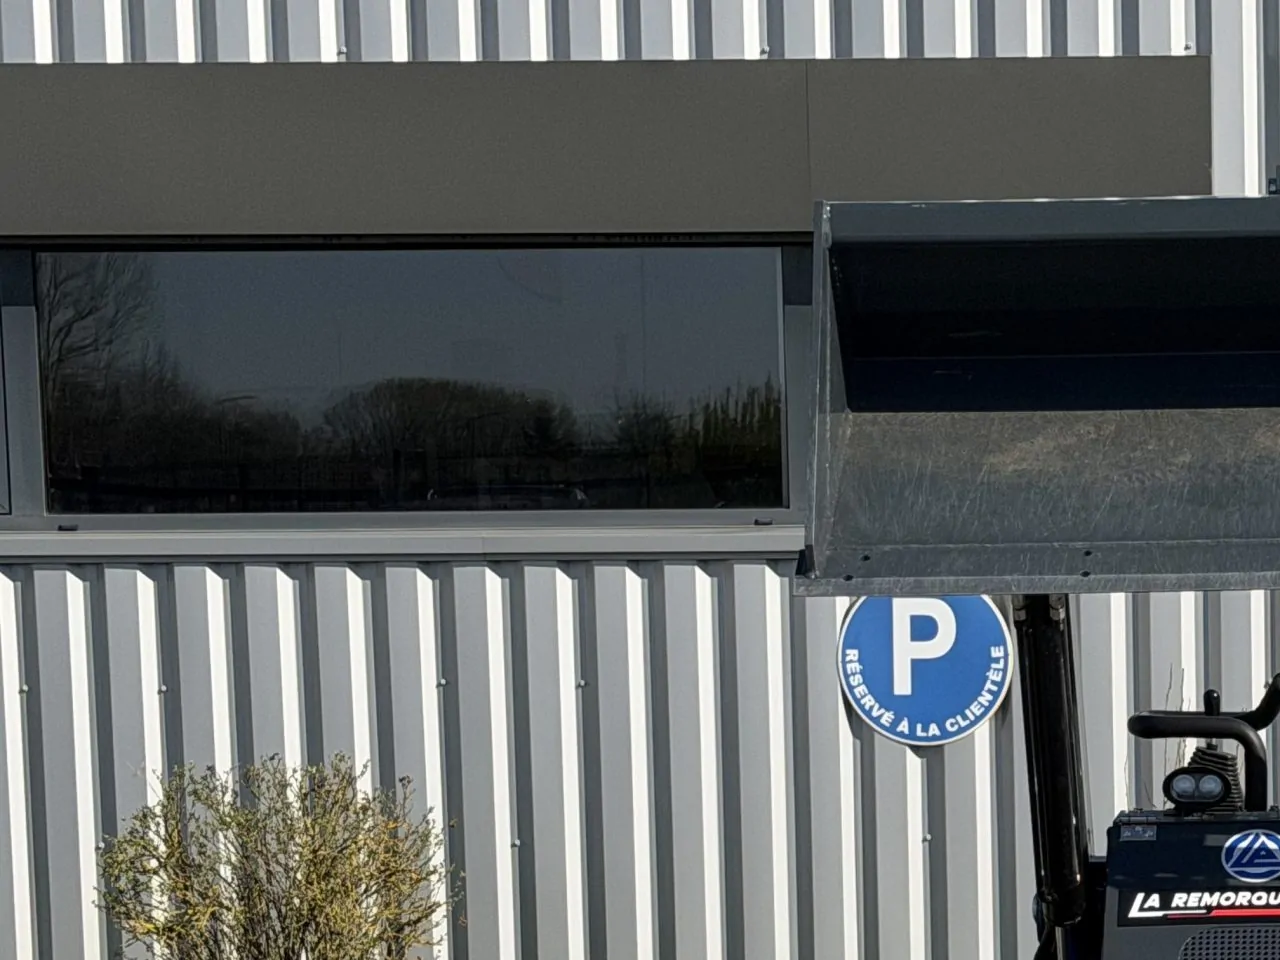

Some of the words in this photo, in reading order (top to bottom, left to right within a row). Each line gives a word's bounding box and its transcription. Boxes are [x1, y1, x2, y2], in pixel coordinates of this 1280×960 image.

[846, 649, 894, 727] RÉSERVÉ
[897, 718, 909, 734] À
[916, 723, 940, 736] LA
[945, 646, 1004, 731] CLIENTÈLE
[893, 597, 956, 695] P
[1128, 892, 1161, 918] LA
